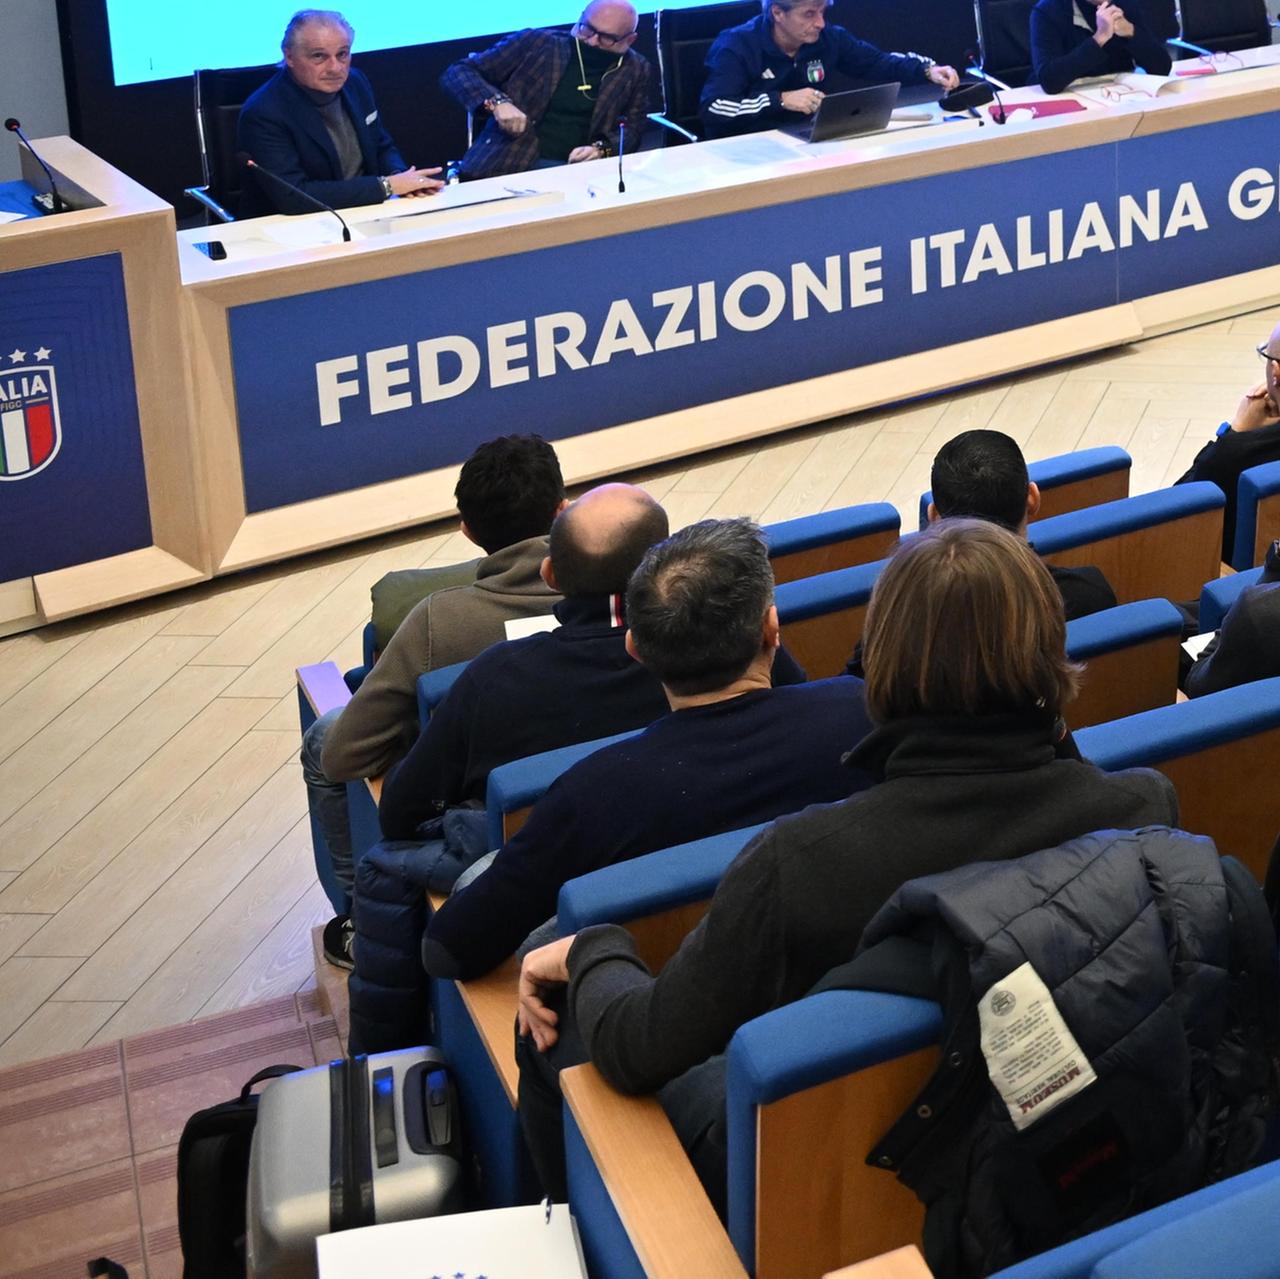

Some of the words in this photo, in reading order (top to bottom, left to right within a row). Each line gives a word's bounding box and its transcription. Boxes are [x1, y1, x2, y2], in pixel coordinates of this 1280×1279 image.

[315, 245, 884, 426] FEDERAZIONE
[910, 181, 1209, 295] ITALIANA
[1018, 1066, 1081, 1115] MUSEUM
